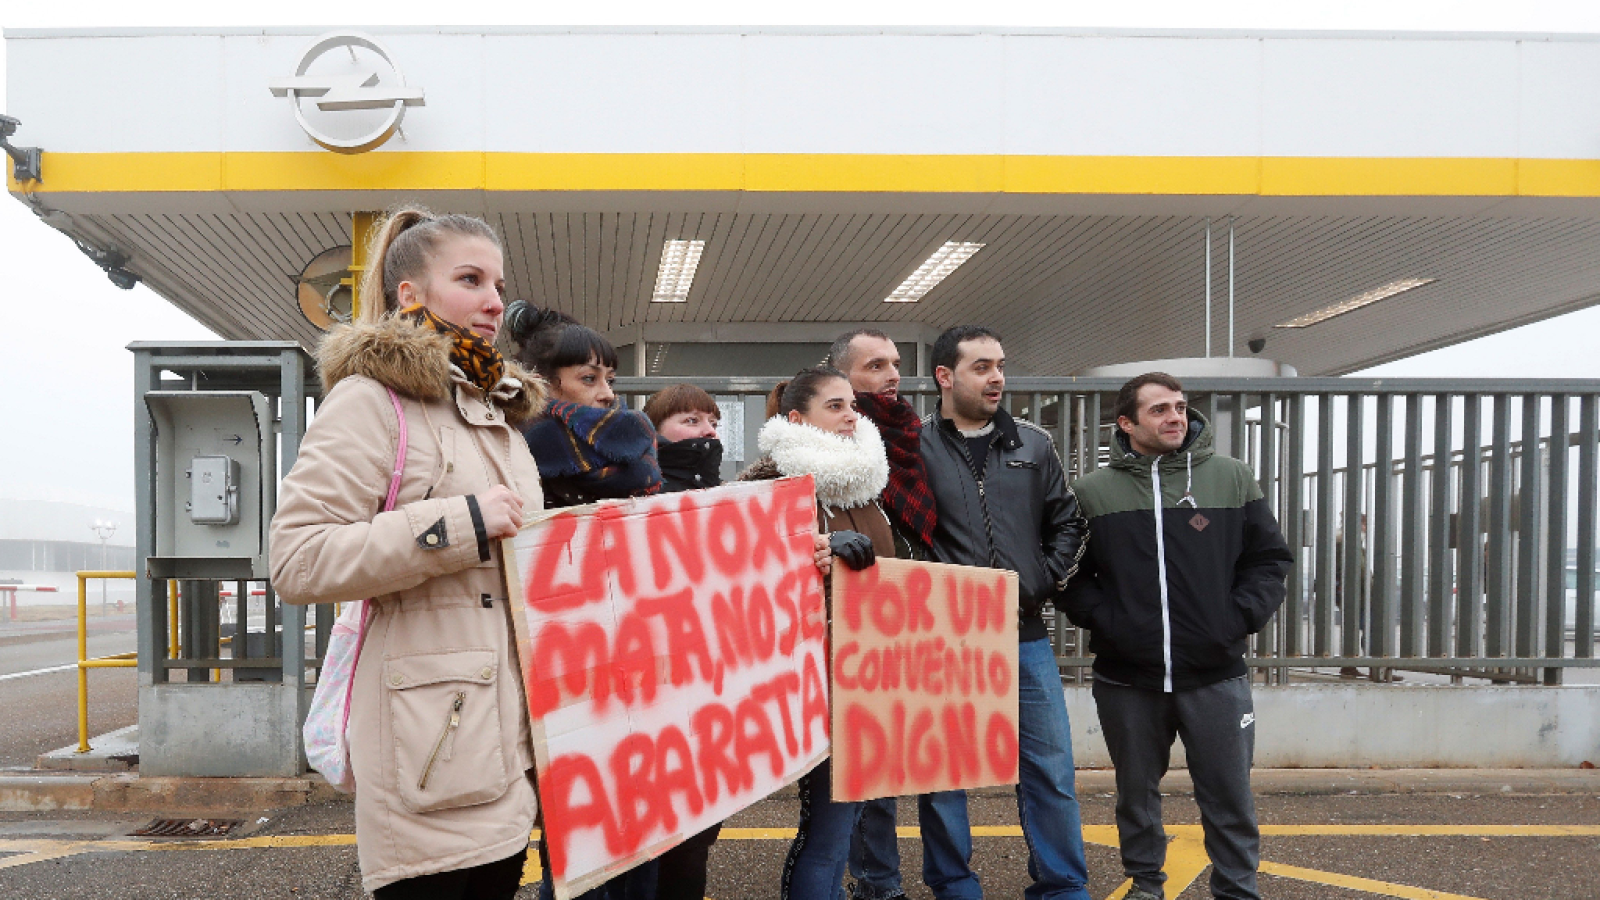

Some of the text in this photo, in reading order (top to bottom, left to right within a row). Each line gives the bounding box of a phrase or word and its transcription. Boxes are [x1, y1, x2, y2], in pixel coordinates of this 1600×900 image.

[842, 560, 1007, 638] POR UN
[833, 635, 1012, 698] CONVENIO
[538, 651, 830, 880] ABARATA
[843, 700, 1018, 801] DIGNO
